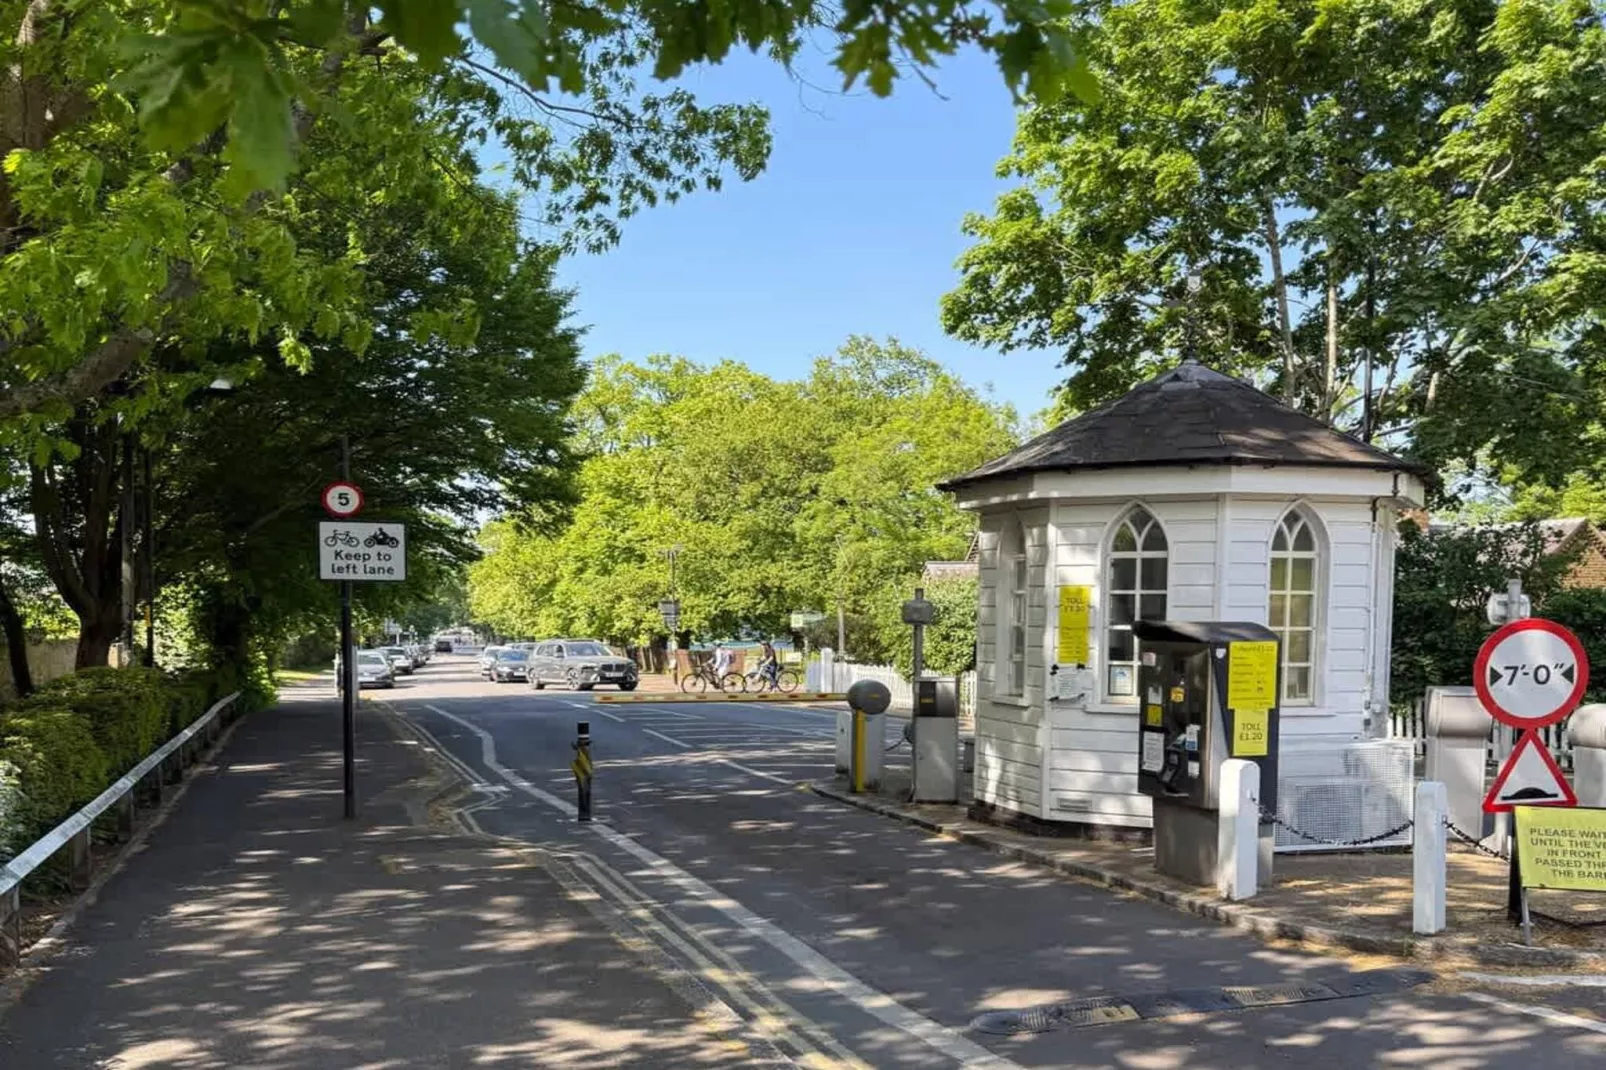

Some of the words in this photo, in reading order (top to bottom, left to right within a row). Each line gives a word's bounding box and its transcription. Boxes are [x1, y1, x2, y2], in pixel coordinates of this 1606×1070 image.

[338, 493, 350, 506] 5
[334, 550, 371, 562] Keep
[376, 551, 392, 562] to
[331, 563, 358, 575] left
[363, 564, 395, 576] lane
[1241, 722, 1261, 731] TOLL
[1239, 732, 1263, 741] £1.20
[1530, 828, 1576, 838] PLEASE
[1530, 838, 1564, 847] UNTIL
[1568, 840, 1591, 849] THE
[1547, 849, 1559, 857] IN
[1562, 850, 1601, 858] FRONT
[1534, 858, 1582, 868] PASSED
[1552, 869, 1575, 878] THE
